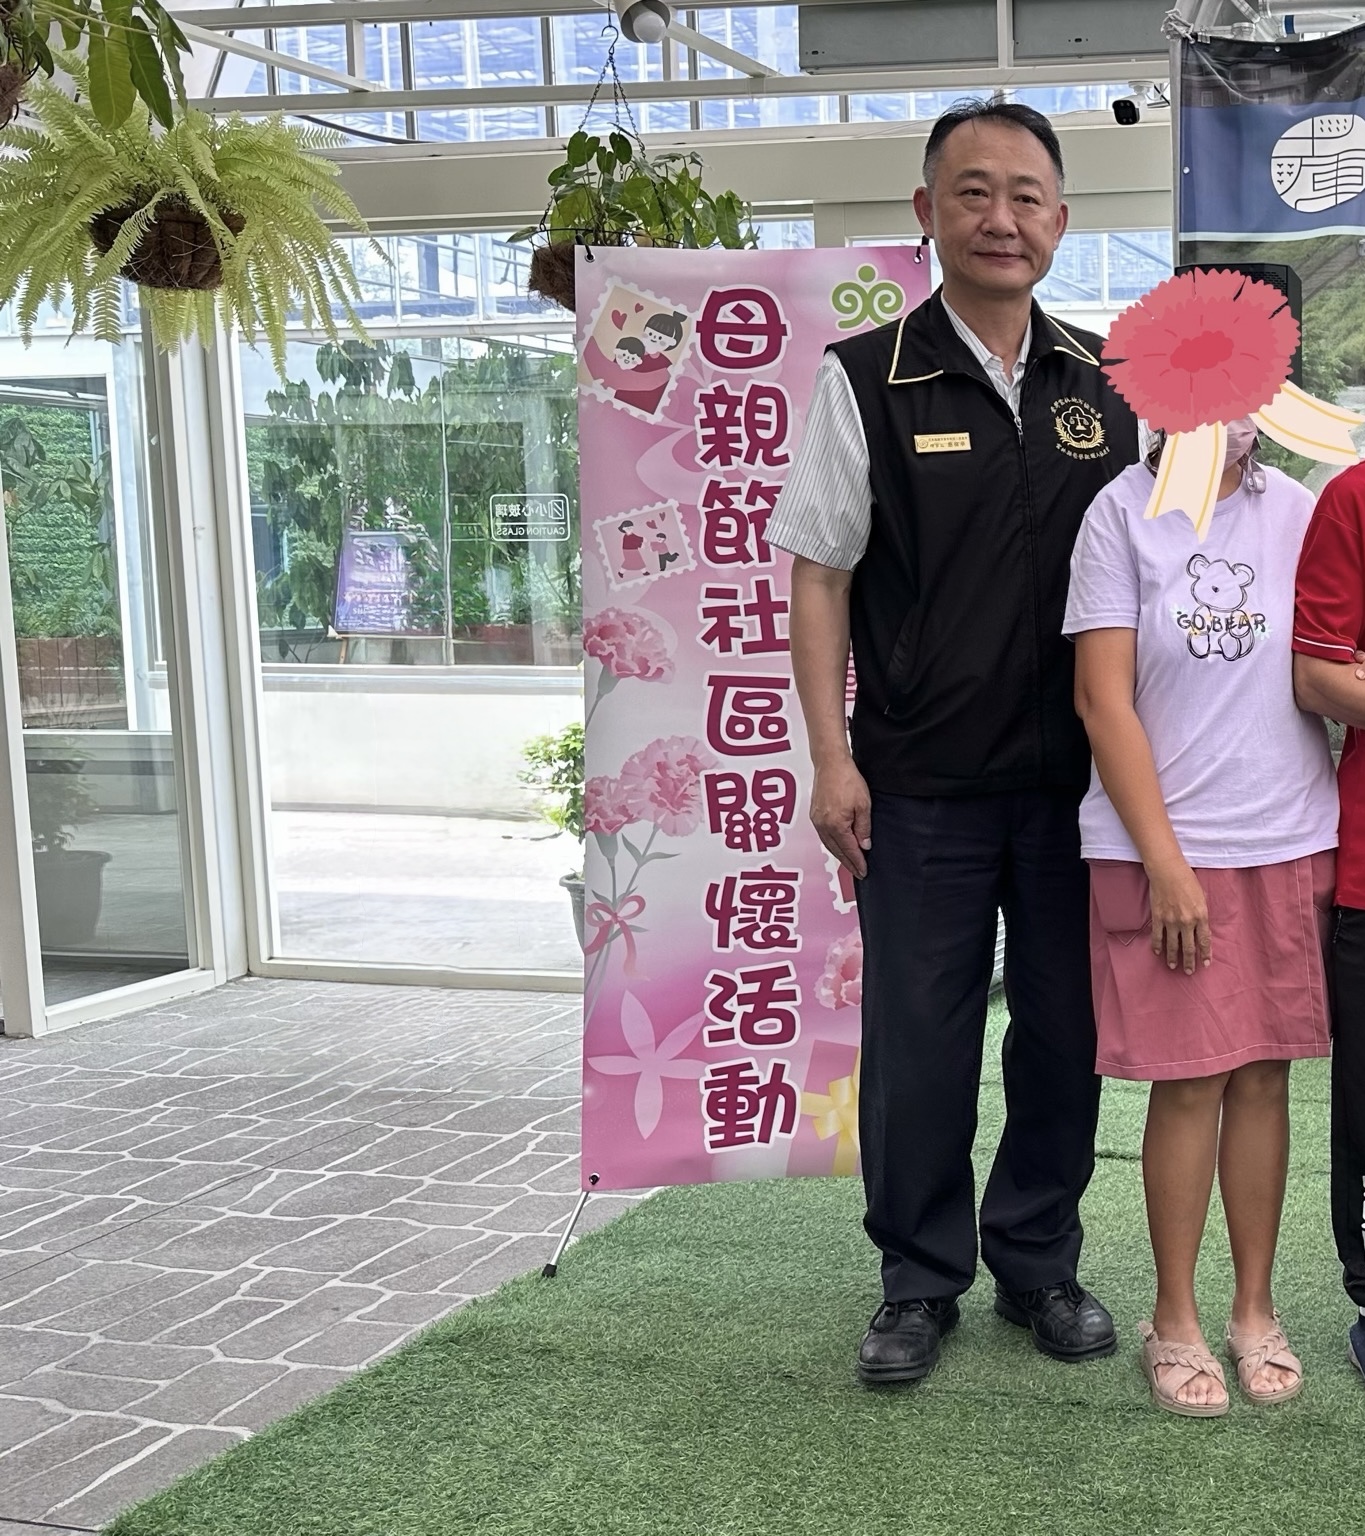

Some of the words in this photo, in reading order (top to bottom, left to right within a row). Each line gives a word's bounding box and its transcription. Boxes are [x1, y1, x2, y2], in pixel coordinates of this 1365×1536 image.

[694, 284, 800, 1152] 母親節社區關懷活動
